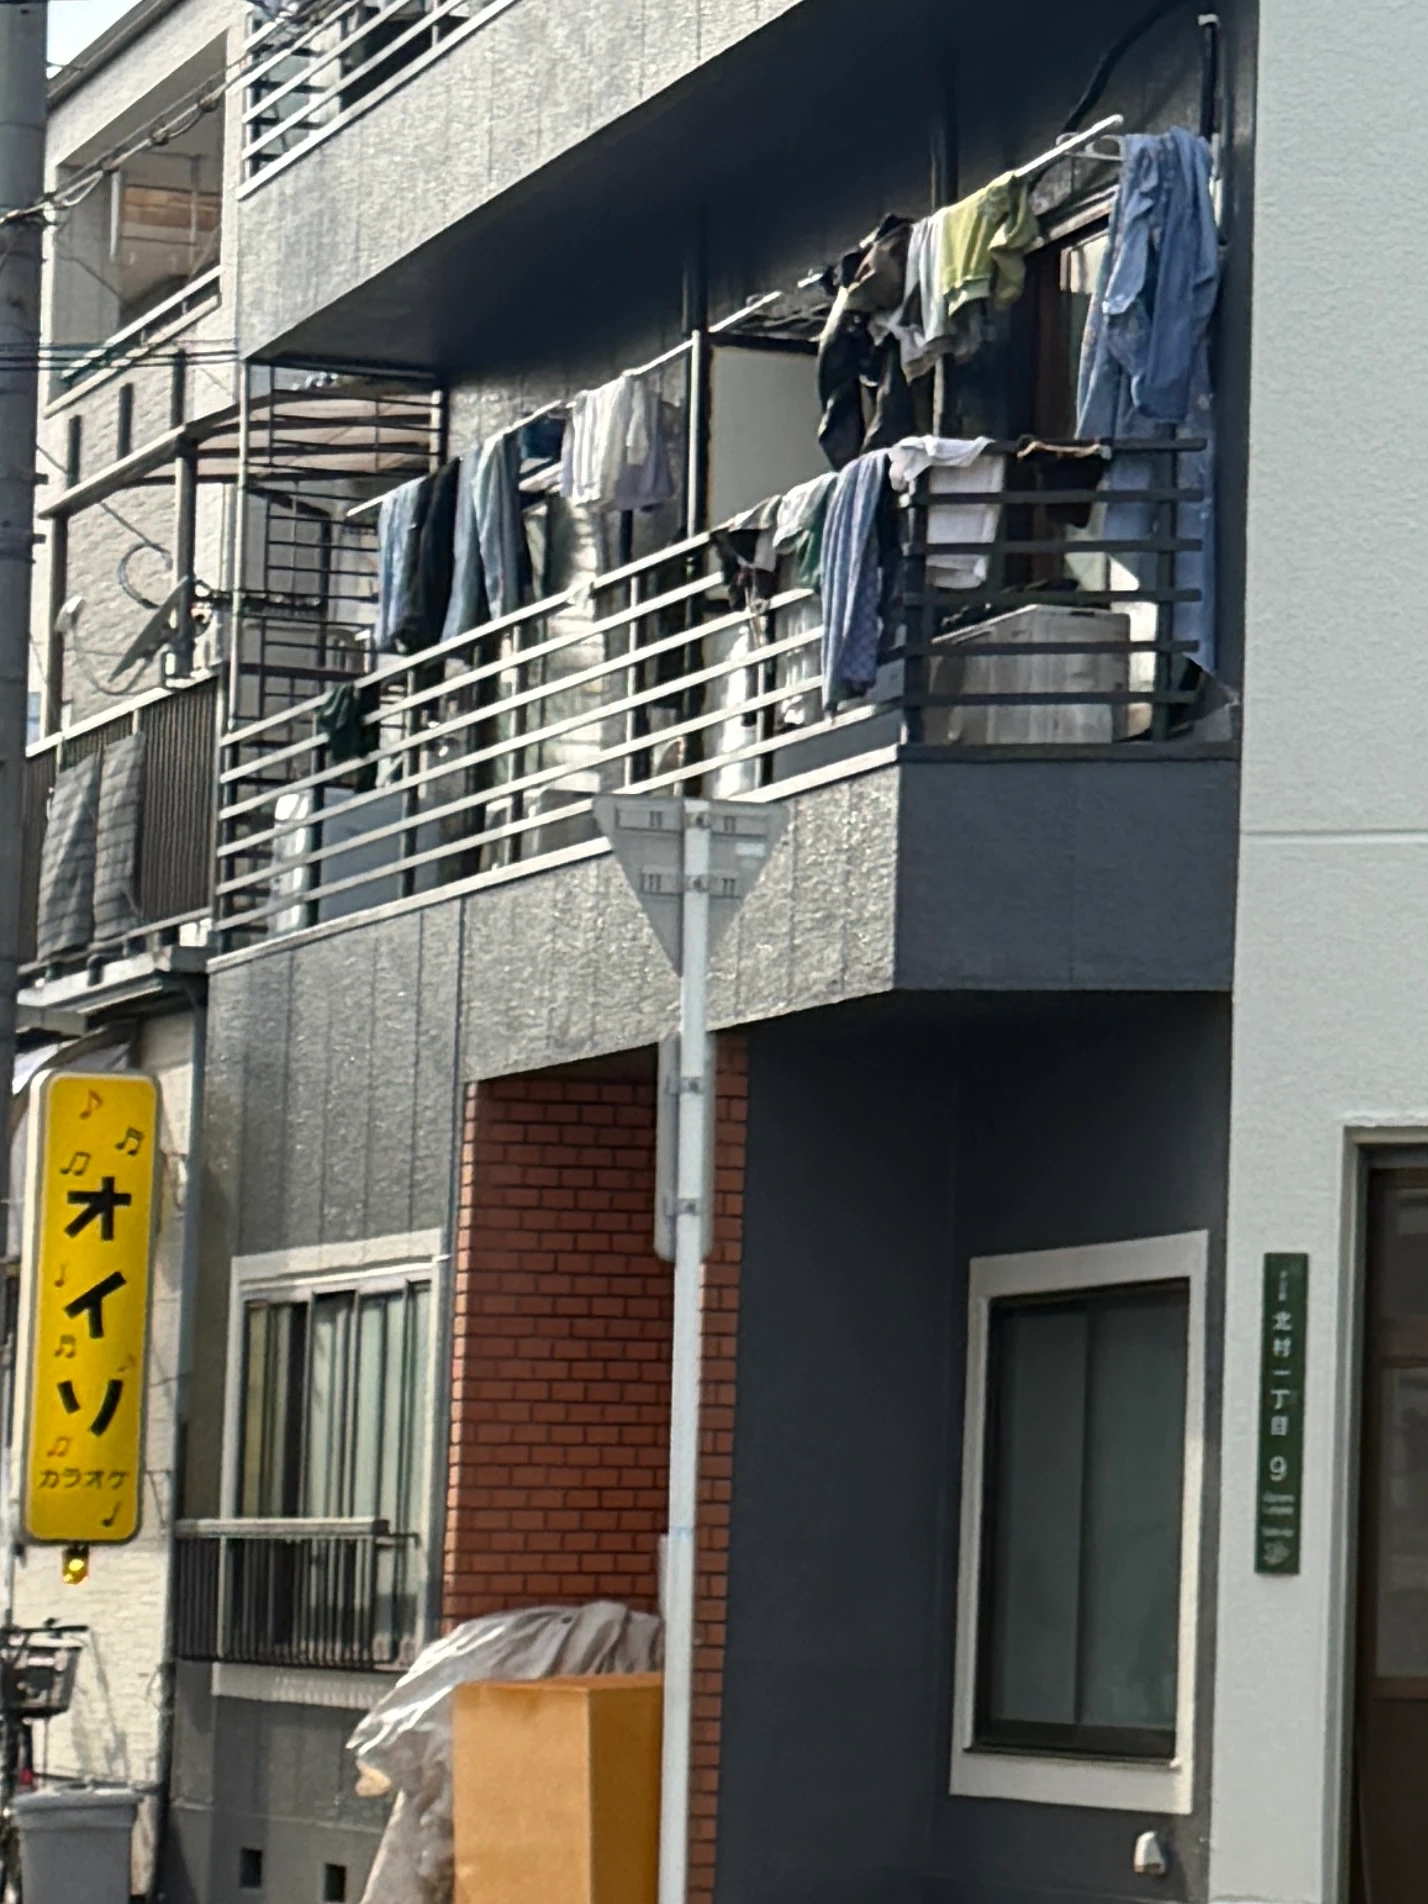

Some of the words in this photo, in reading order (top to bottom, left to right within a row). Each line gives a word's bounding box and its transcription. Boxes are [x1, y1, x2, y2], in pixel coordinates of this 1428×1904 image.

[56, 1176, 132, 1437] オイソ
[38, 1468, 130, 1490] カラオケ
